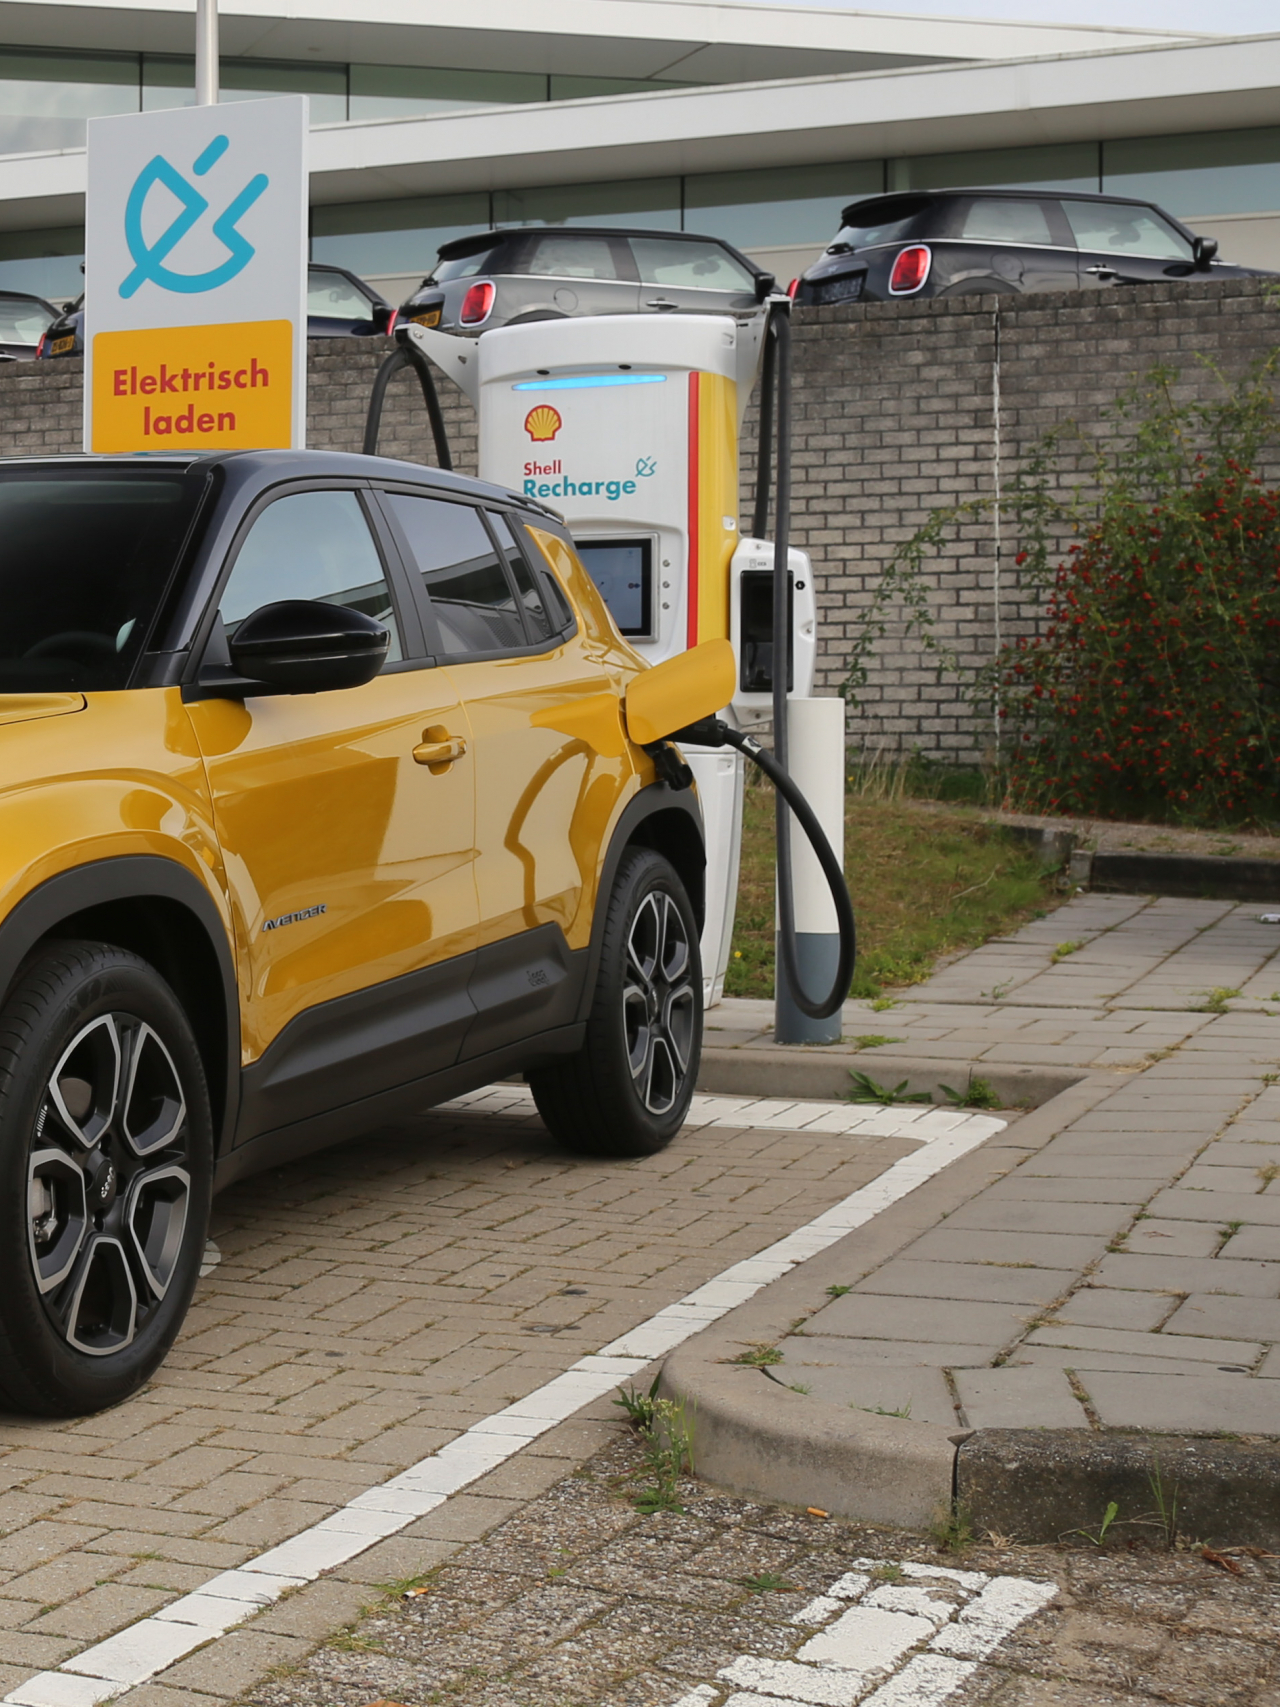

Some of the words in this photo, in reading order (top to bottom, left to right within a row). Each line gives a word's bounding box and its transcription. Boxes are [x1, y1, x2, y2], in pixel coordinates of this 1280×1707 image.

[113, 357, 270, 397] Elektrisch
[143, 403, 237, 436] laden
[523, 459, 562, 476] Shell
[523, 475, 637, 501] Recharge
